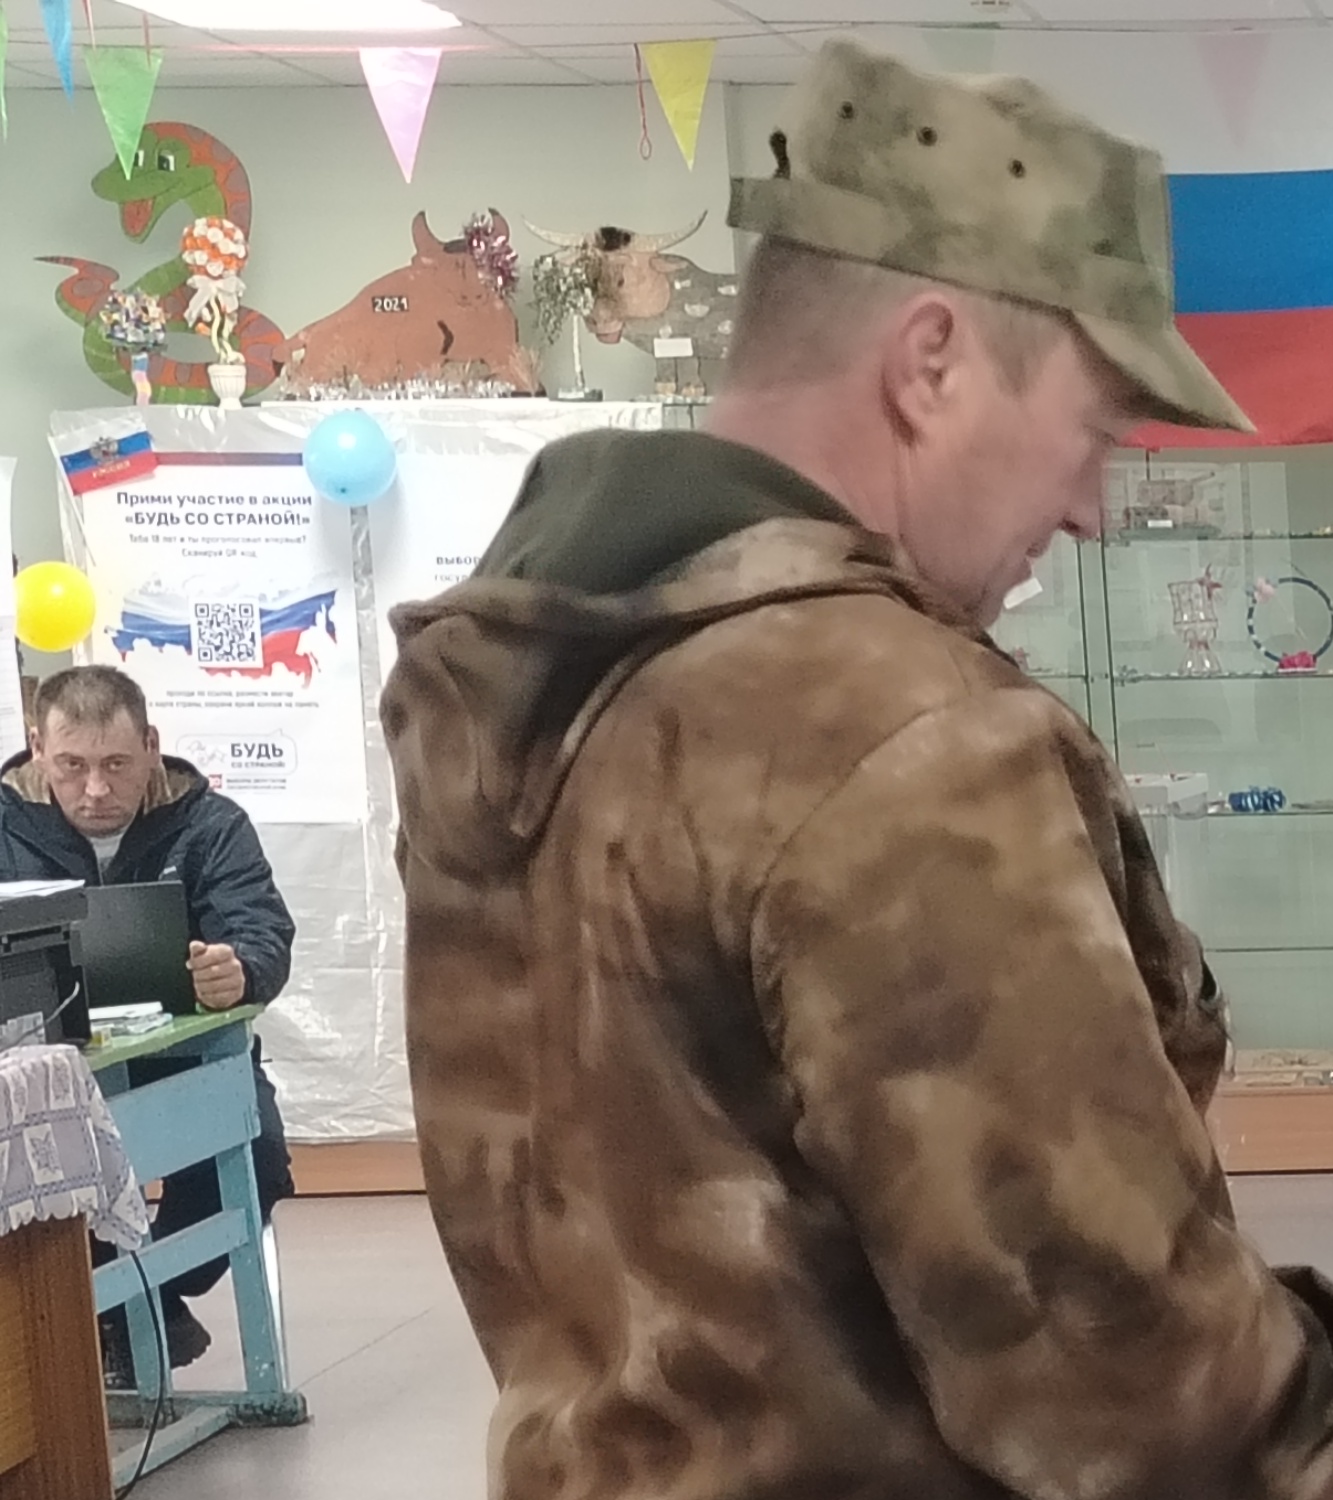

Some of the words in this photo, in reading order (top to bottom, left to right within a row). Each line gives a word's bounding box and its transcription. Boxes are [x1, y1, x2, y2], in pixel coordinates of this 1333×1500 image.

[375, 297, 408, 312] 2021
[117, 491, 173, 508] Прими
[176, 494, 245, 508] участие
[249, 495, 258, 505] в
[262, 494, 312, 507] акции
[125, 511, 181, 527] «БУДЬ
[184, 512, 209, 525] СО
[213, 510, 311, 526] СТРАНОЙ!»
[436, 556, 481, 566] ВЫБОР
[230, 742, 284, 760] БУДЬ
